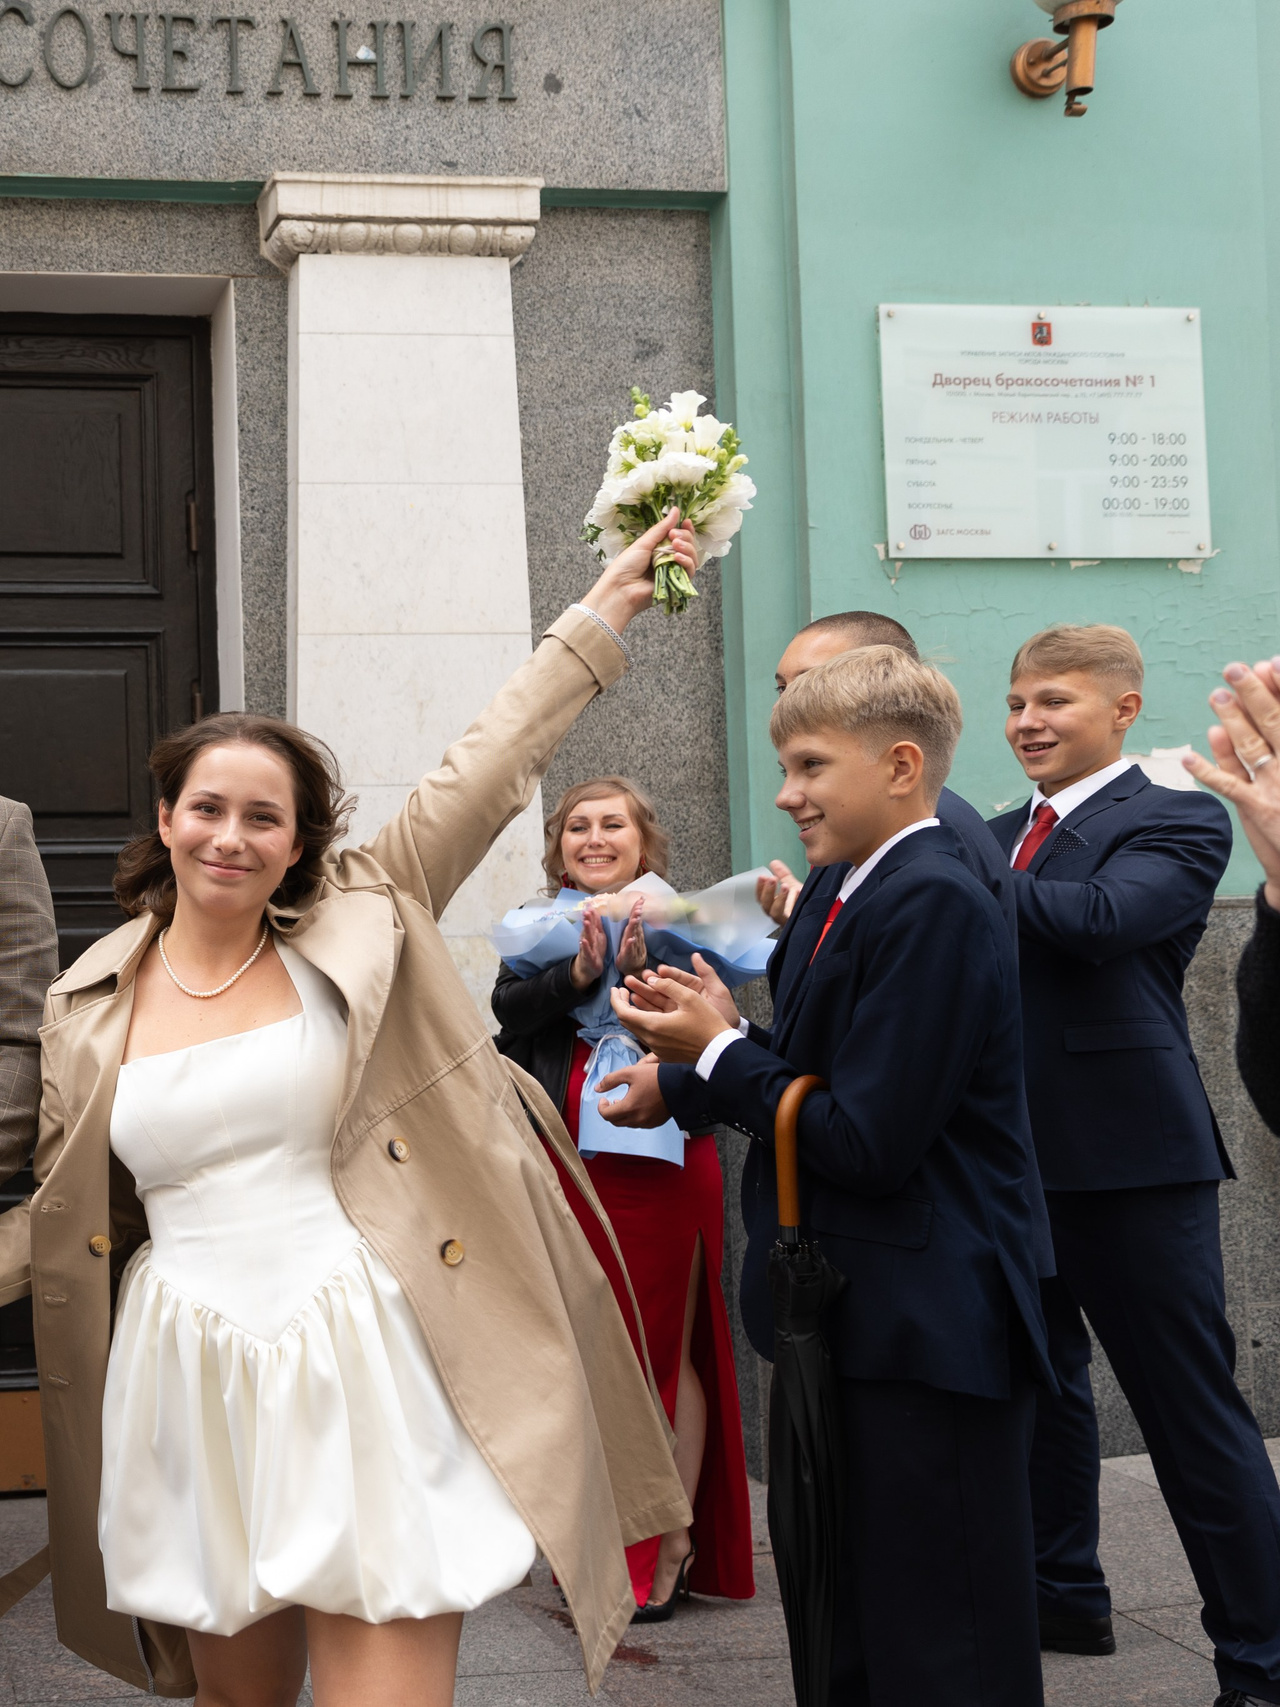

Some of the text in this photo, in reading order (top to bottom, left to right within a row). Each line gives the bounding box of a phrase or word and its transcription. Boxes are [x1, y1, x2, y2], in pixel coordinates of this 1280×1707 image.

[931, 372, 992, 390] Дворец
[994, 373, 1121, 391] бракосочетания
[1148, 374, 1157, 388] 1
[991, 411, 1100, 425] РЕЖИМ РАБОТЫ
[1107, 431, 1138, 446] 9:00
[1152, 432, 1187, 446] 18:00
[1108, 453, 1140, 467] 9:00
[1150, 453, 1188, 467] 20:00
[1109, 475, 1141, 489] 9:00
[1151, 475, 1189, 489] 23:59
[1101, 496, 1141, 511] 00:00
[1153, 497, 1190, 511] 19:00
